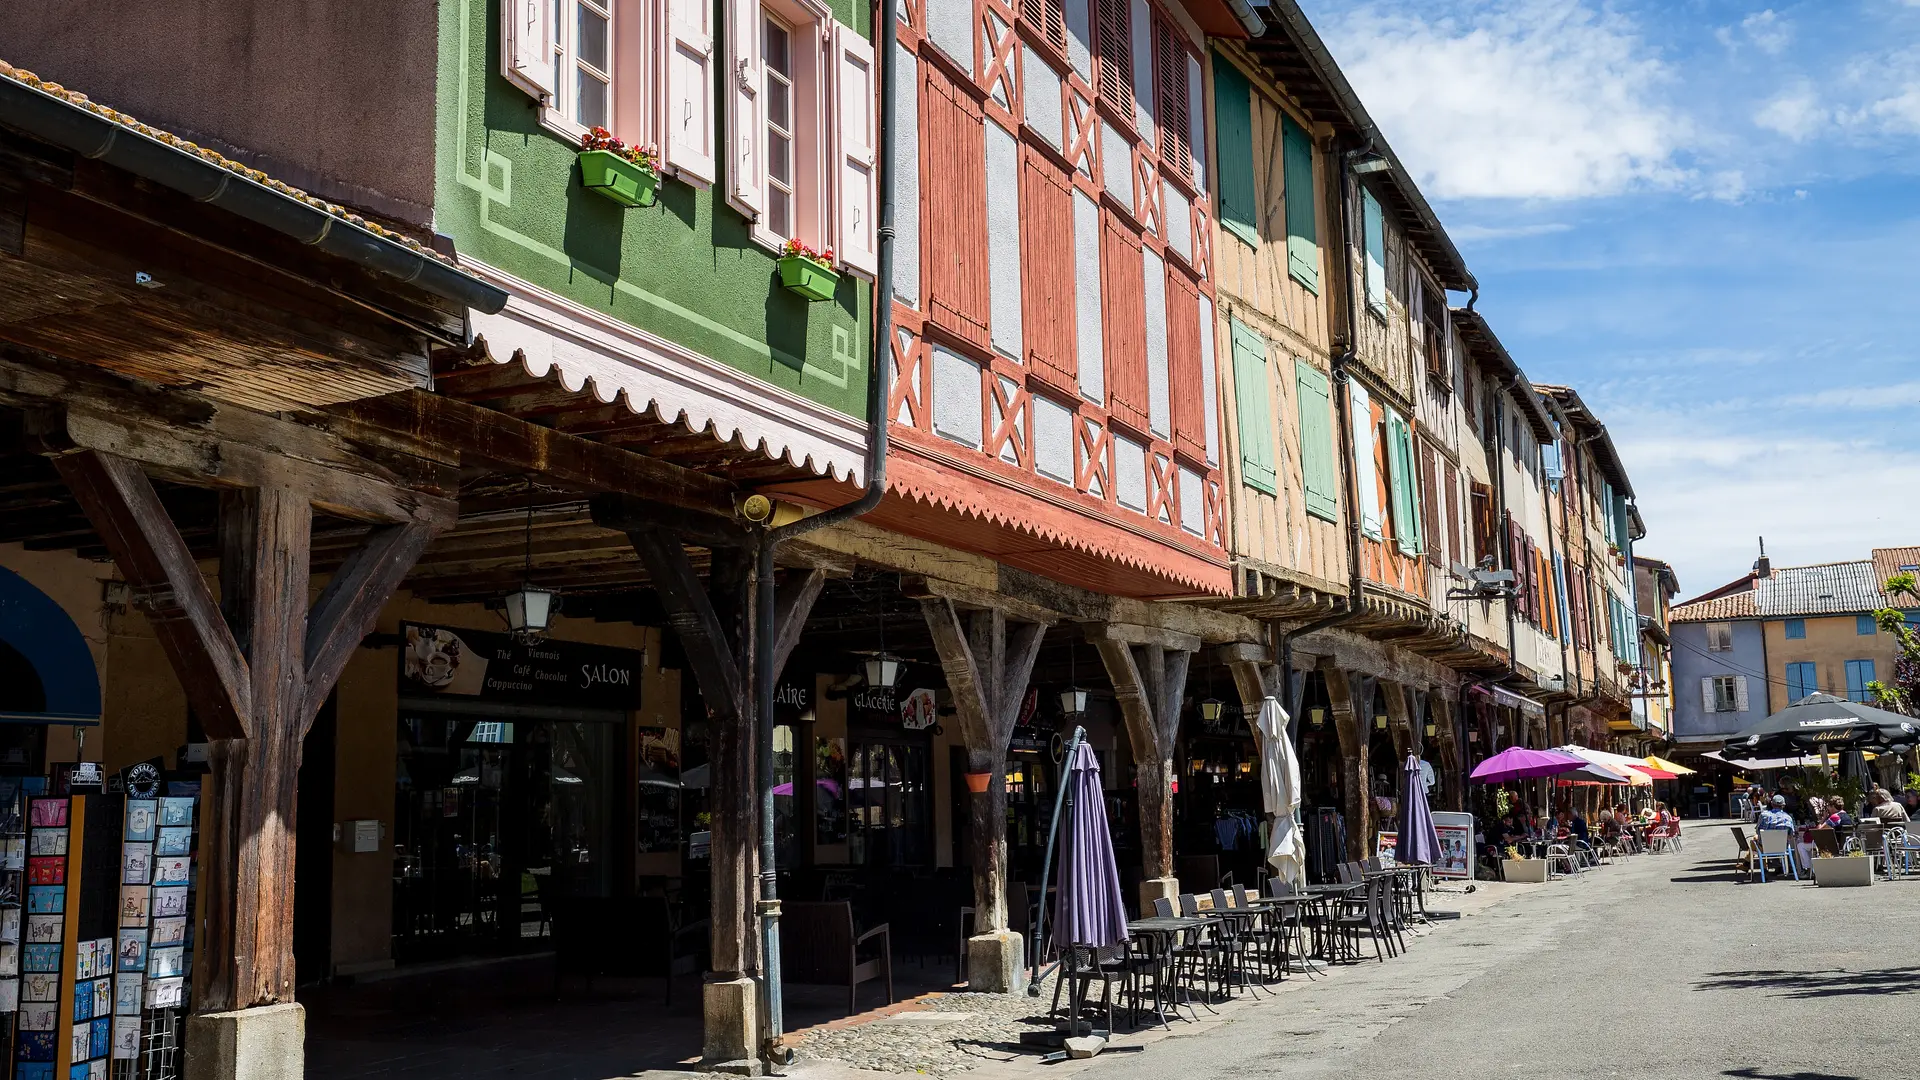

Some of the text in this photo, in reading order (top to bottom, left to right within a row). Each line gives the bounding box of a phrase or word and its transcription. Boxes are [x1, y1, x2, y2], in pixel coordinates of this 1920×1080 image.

[496, 648, 560, 661] Thé Viennois
[513, 663, 567, 682] Café Chocolat
[580, 663, 630, 689] SALON
[487, 677, 533, 691] Cappuccino
[854, 692, 895, 713] GLACERIE
[1812, 727, 1853, 741] Black
